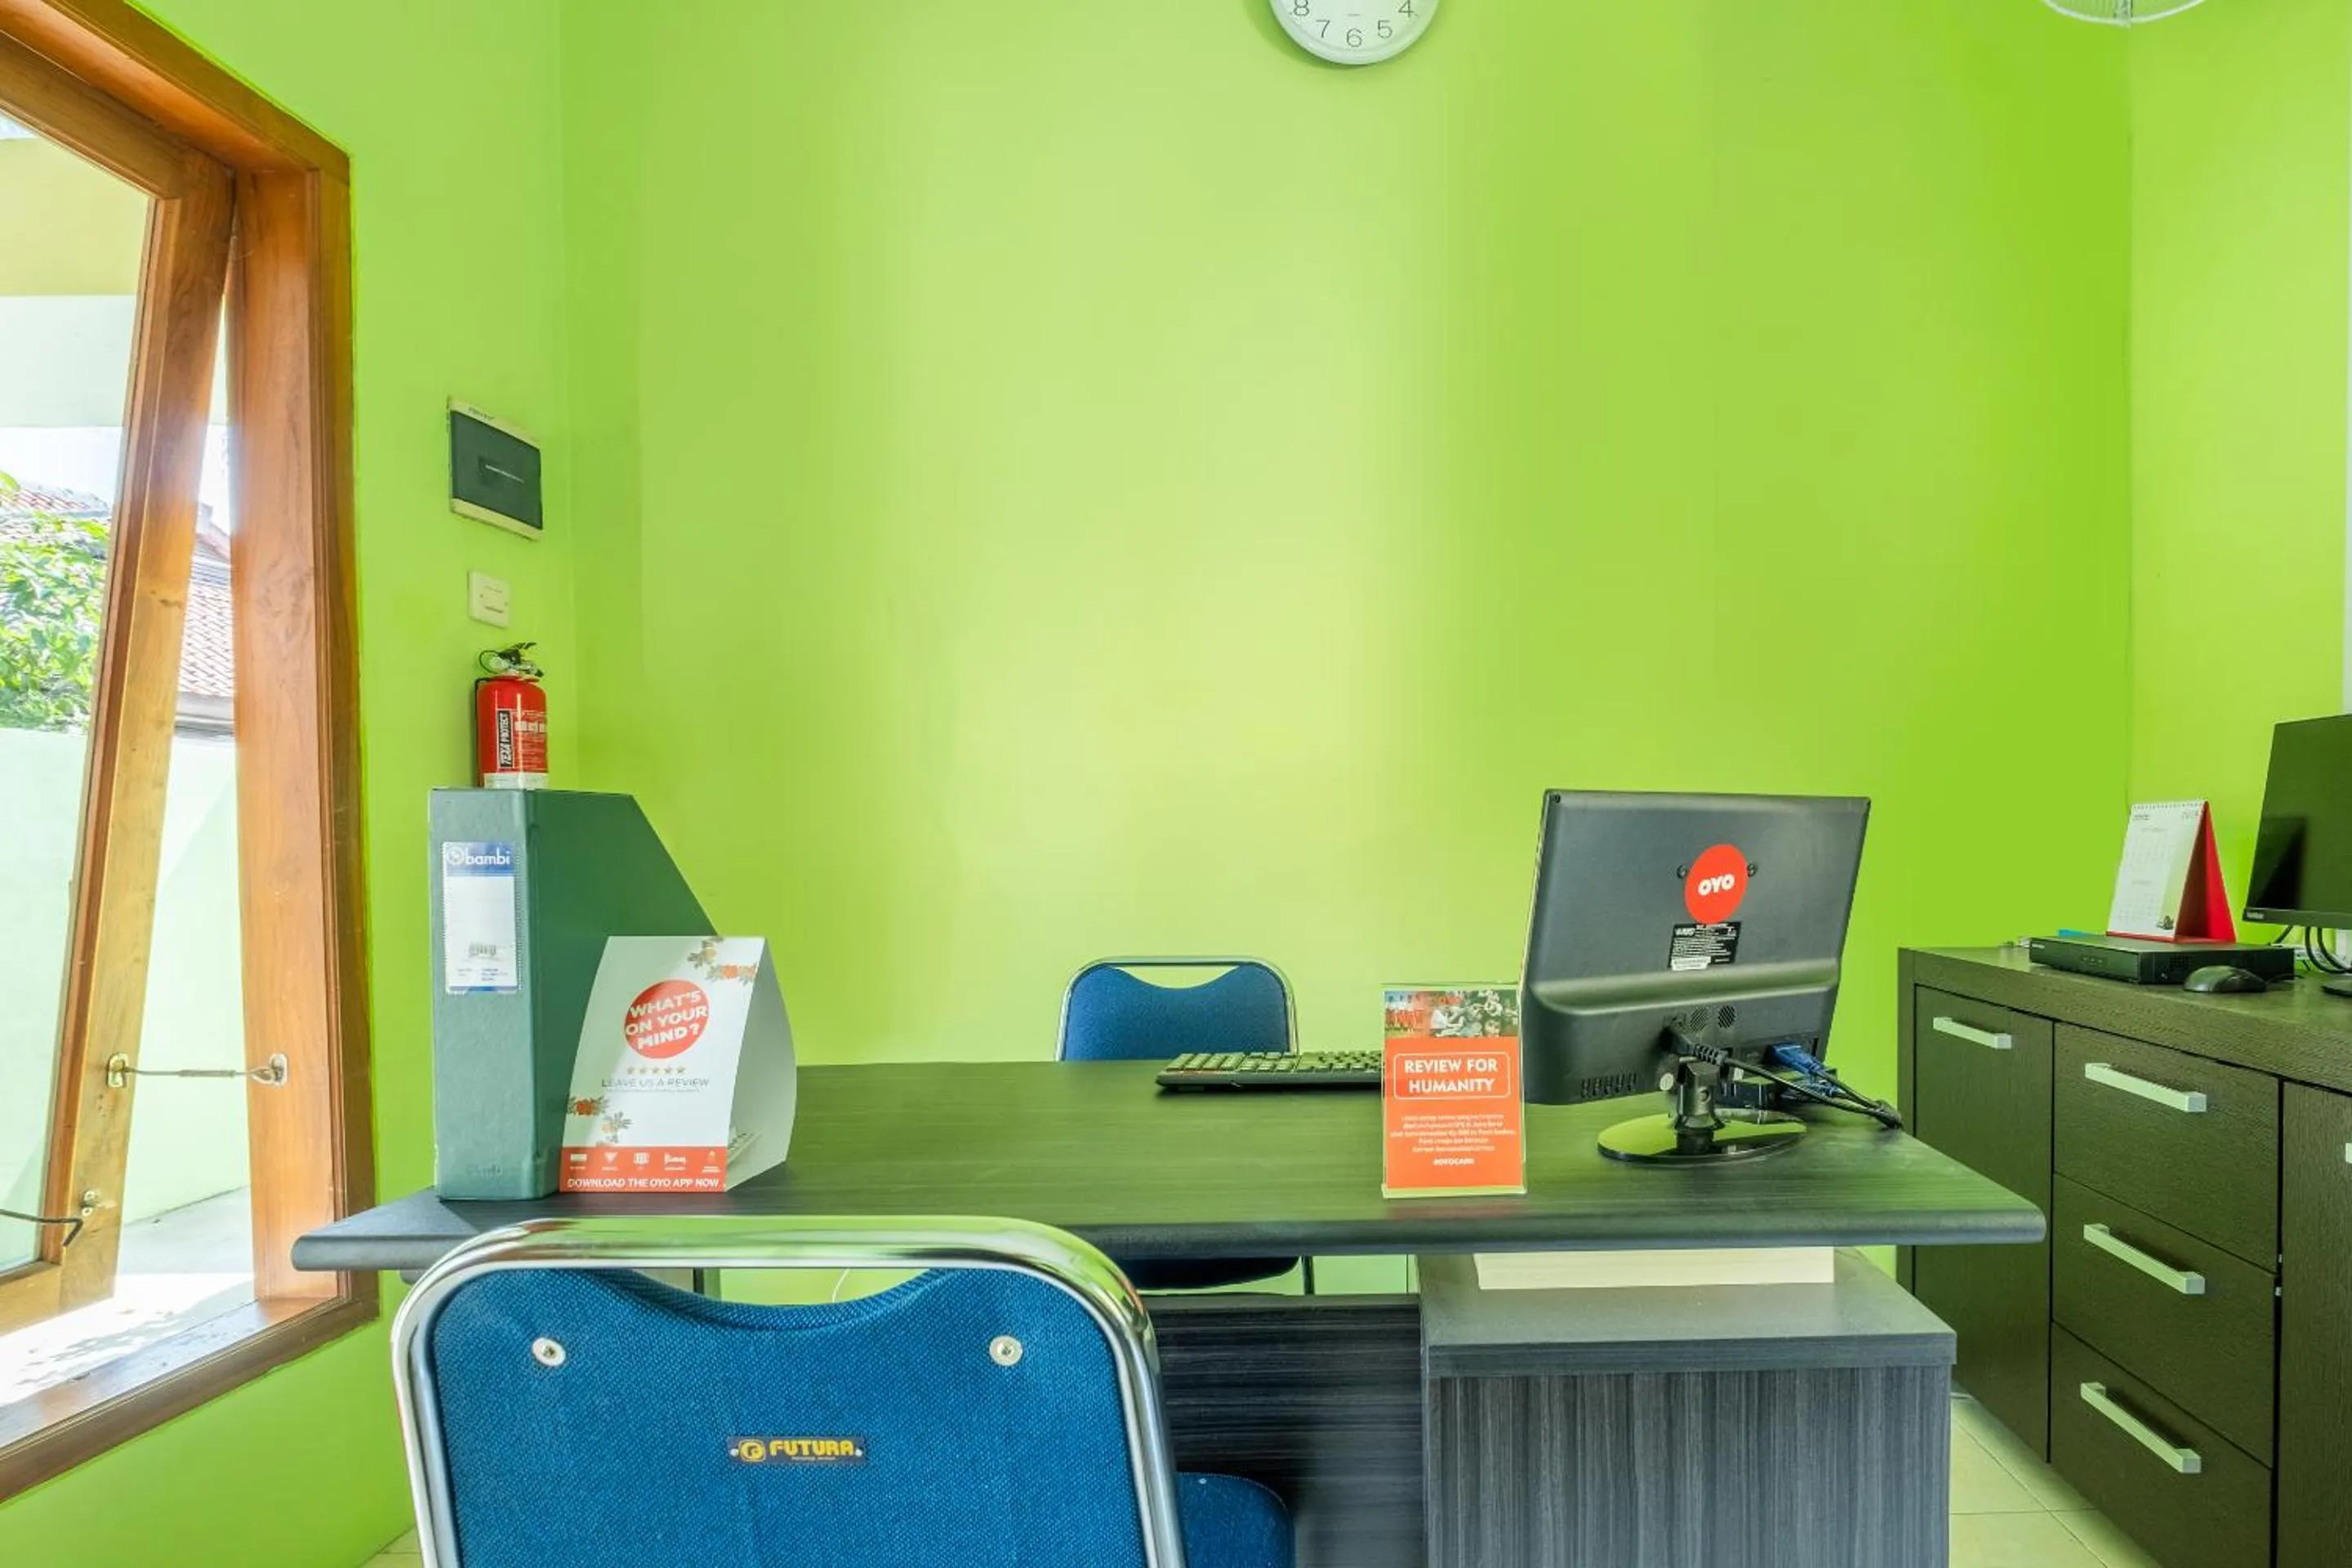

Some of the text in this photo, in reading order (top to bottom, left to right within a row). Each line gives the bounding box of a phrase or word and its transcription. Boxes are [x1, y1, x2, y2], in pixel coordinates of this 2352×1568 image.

[1293, 0, 1310, 16] 8
[1397, 0, 1414, 17] 4
[1316, 19, 1331, 38] 7
[1346, 28, 1363, 47] 6
[1377, 20, 1393, 38] 5
[465, 847, 510, 866] bambi
[1698, 874, 1735, 896] OYO
[630, 991, 702, 1018] WHAT'S
[626, 1005, 708, 1036] ON YOUR
[637, 1022, 700, 1049] MIND?
[1404, 1058, 1499, 1074] REVIEW FOR
[601, 1078, 710, 1088] LEAVE US A REVIEW
[1408, 1078, 1496, 1094] HUMANITY
[568, 1178, 719, 1188] DOWNLOAD THE OYO APP NOW
[769, 1440, 854, 1457] FUTURA
